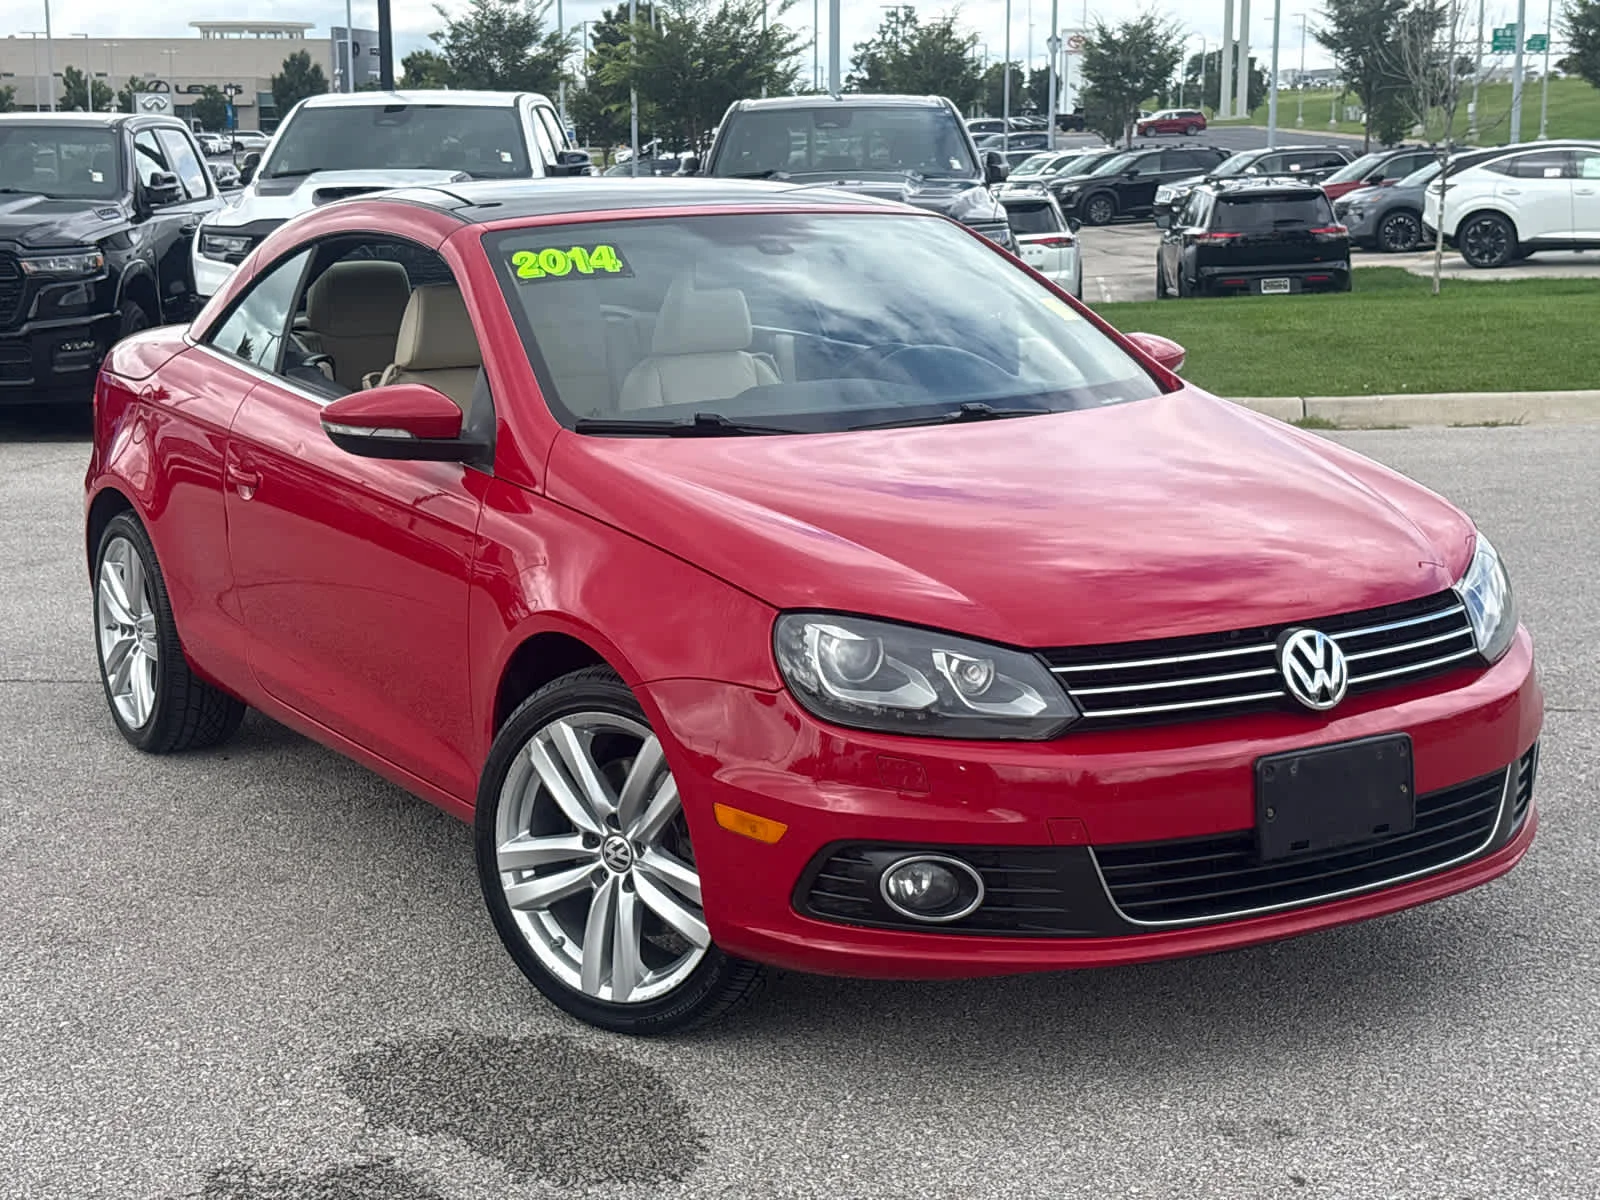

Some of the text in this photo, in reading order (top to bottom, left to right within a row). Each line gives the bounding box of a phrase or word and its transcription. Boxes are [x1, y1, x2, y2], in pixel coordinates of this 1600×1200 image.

[174, 84, 243, 95] LES
[512, 245, 623, 279] 2014
[1283, 630, 1346, 709] VW
